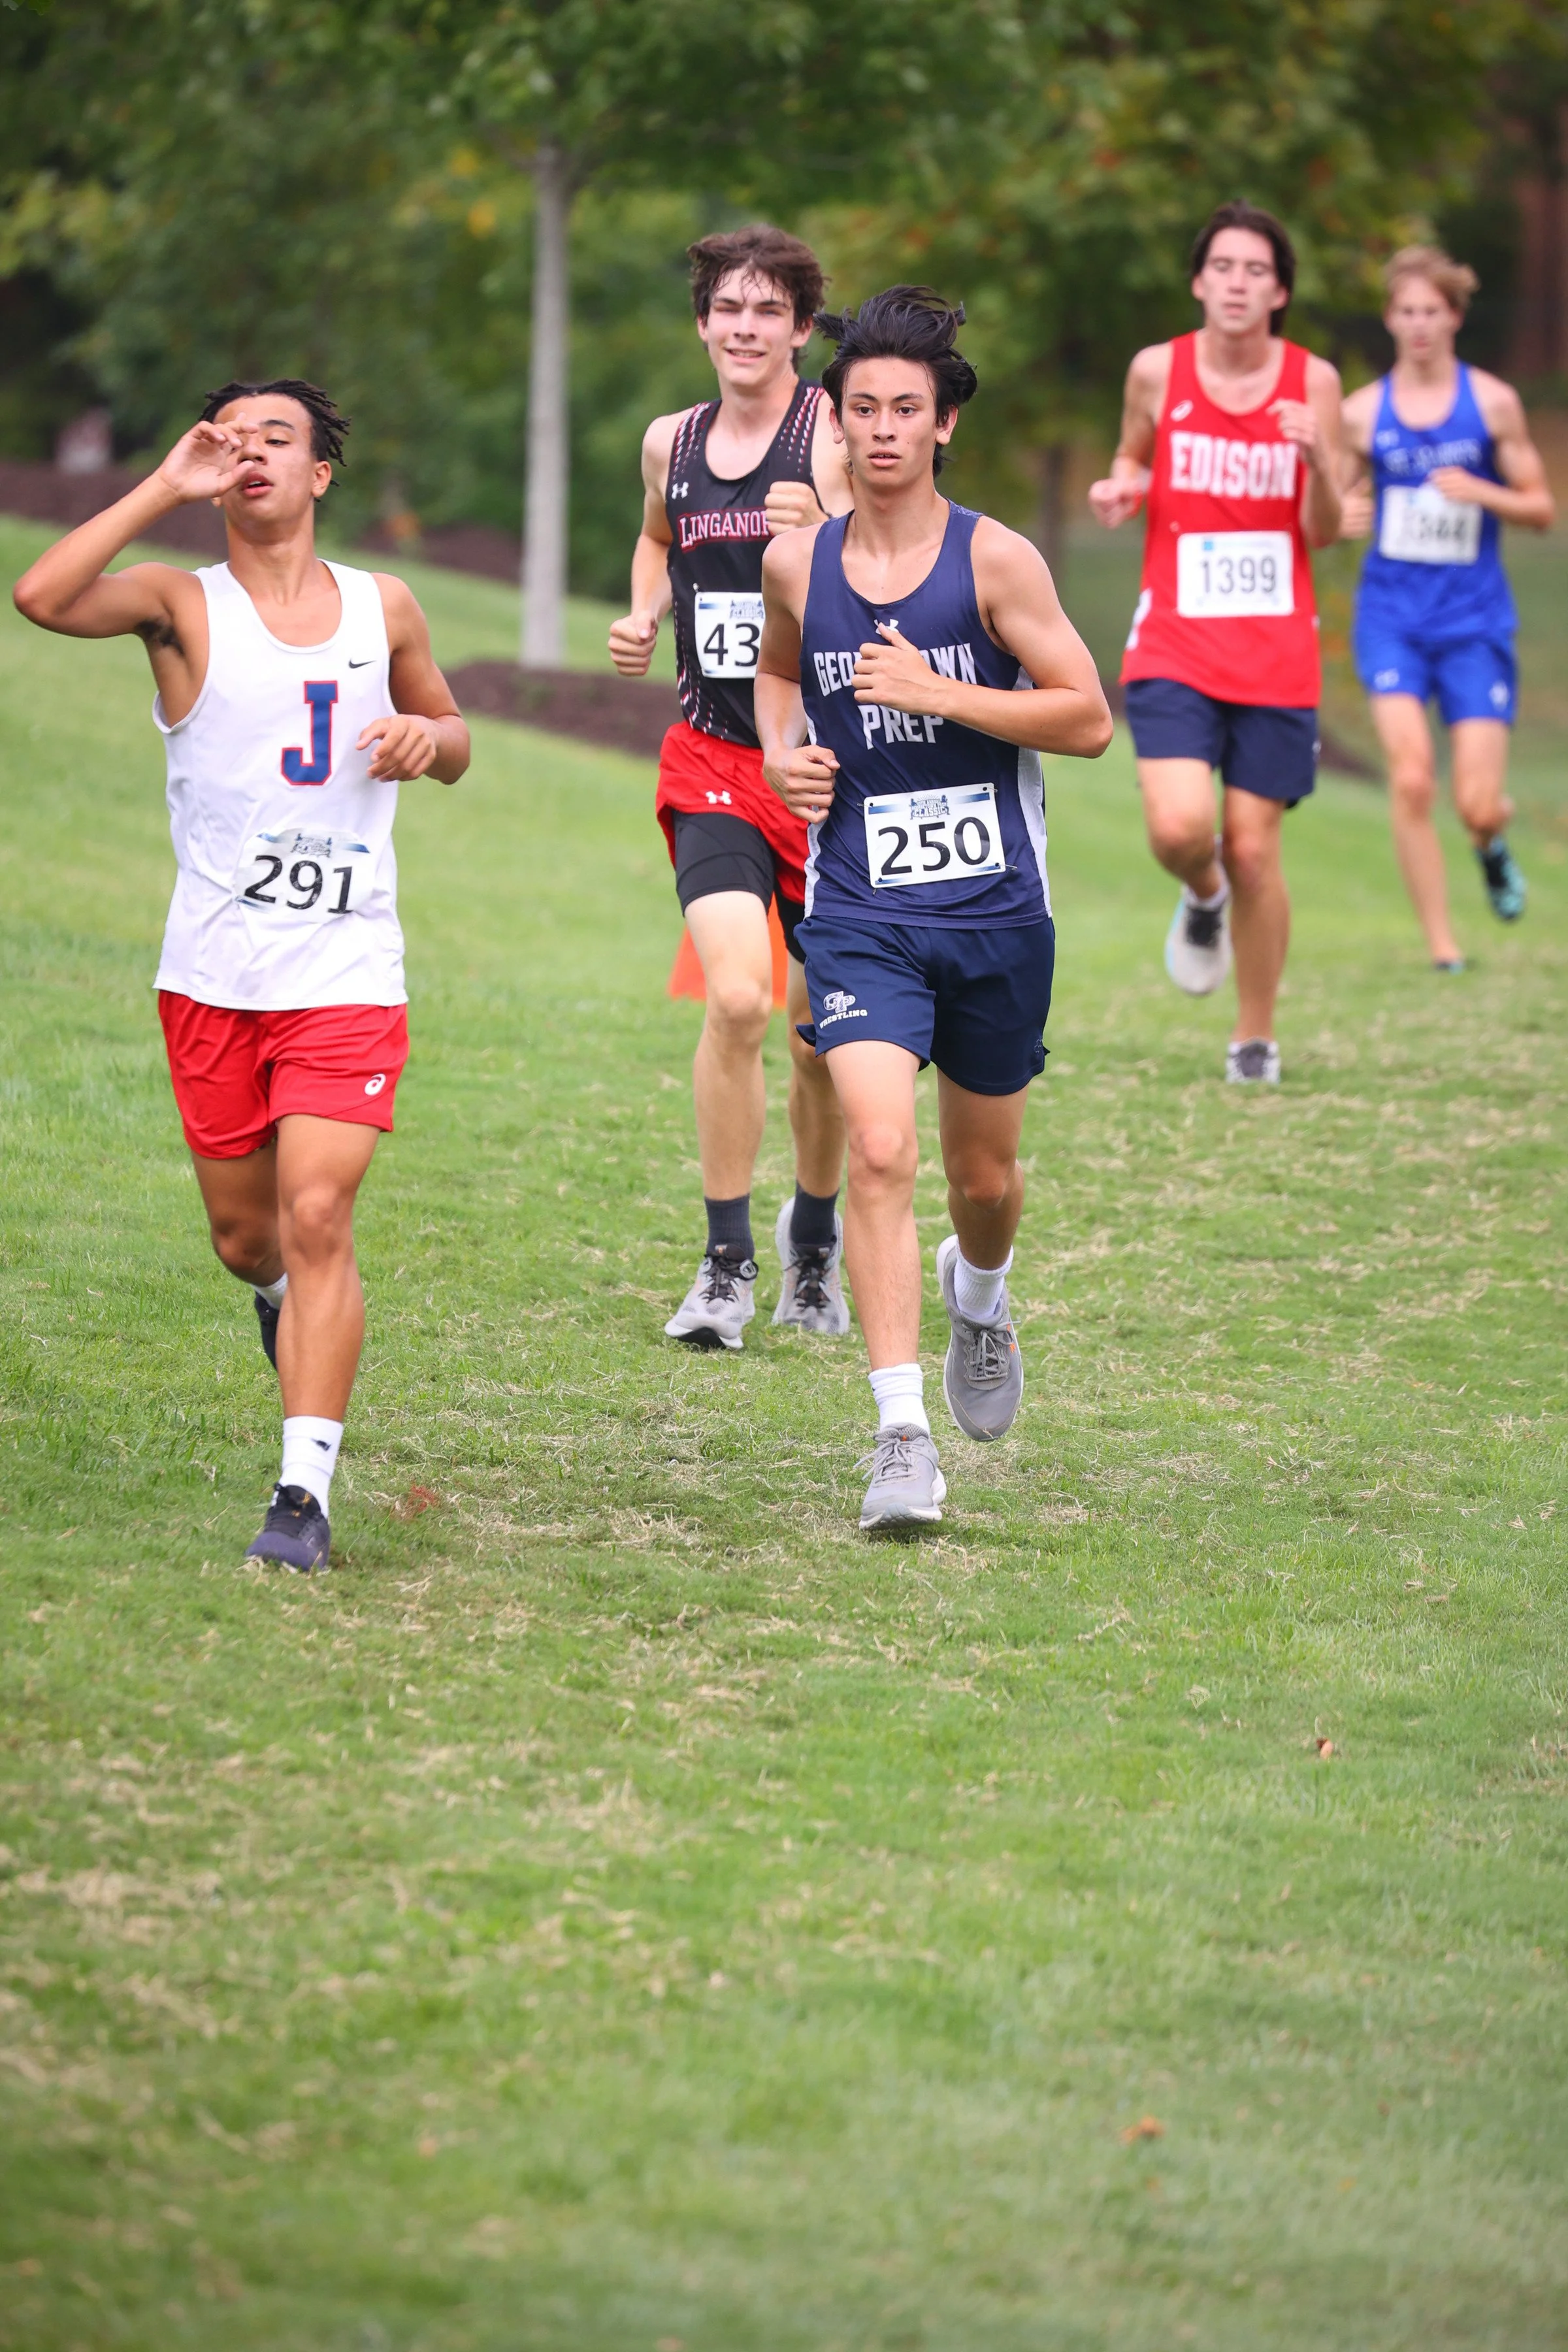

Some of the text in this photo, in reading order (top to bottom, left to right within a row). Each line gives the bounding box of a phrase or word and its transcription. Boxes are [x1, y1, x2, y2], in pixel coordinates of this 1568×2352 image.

[1170, 431, 1298, 499] EDISON
[1201, 556, 1277, 595] 1399
[281, 680, 338, 785] J
[857, 704, 944, 750] PREP
[877, 817, 991, 875] 250
[243, 855, 354, 915] 291
